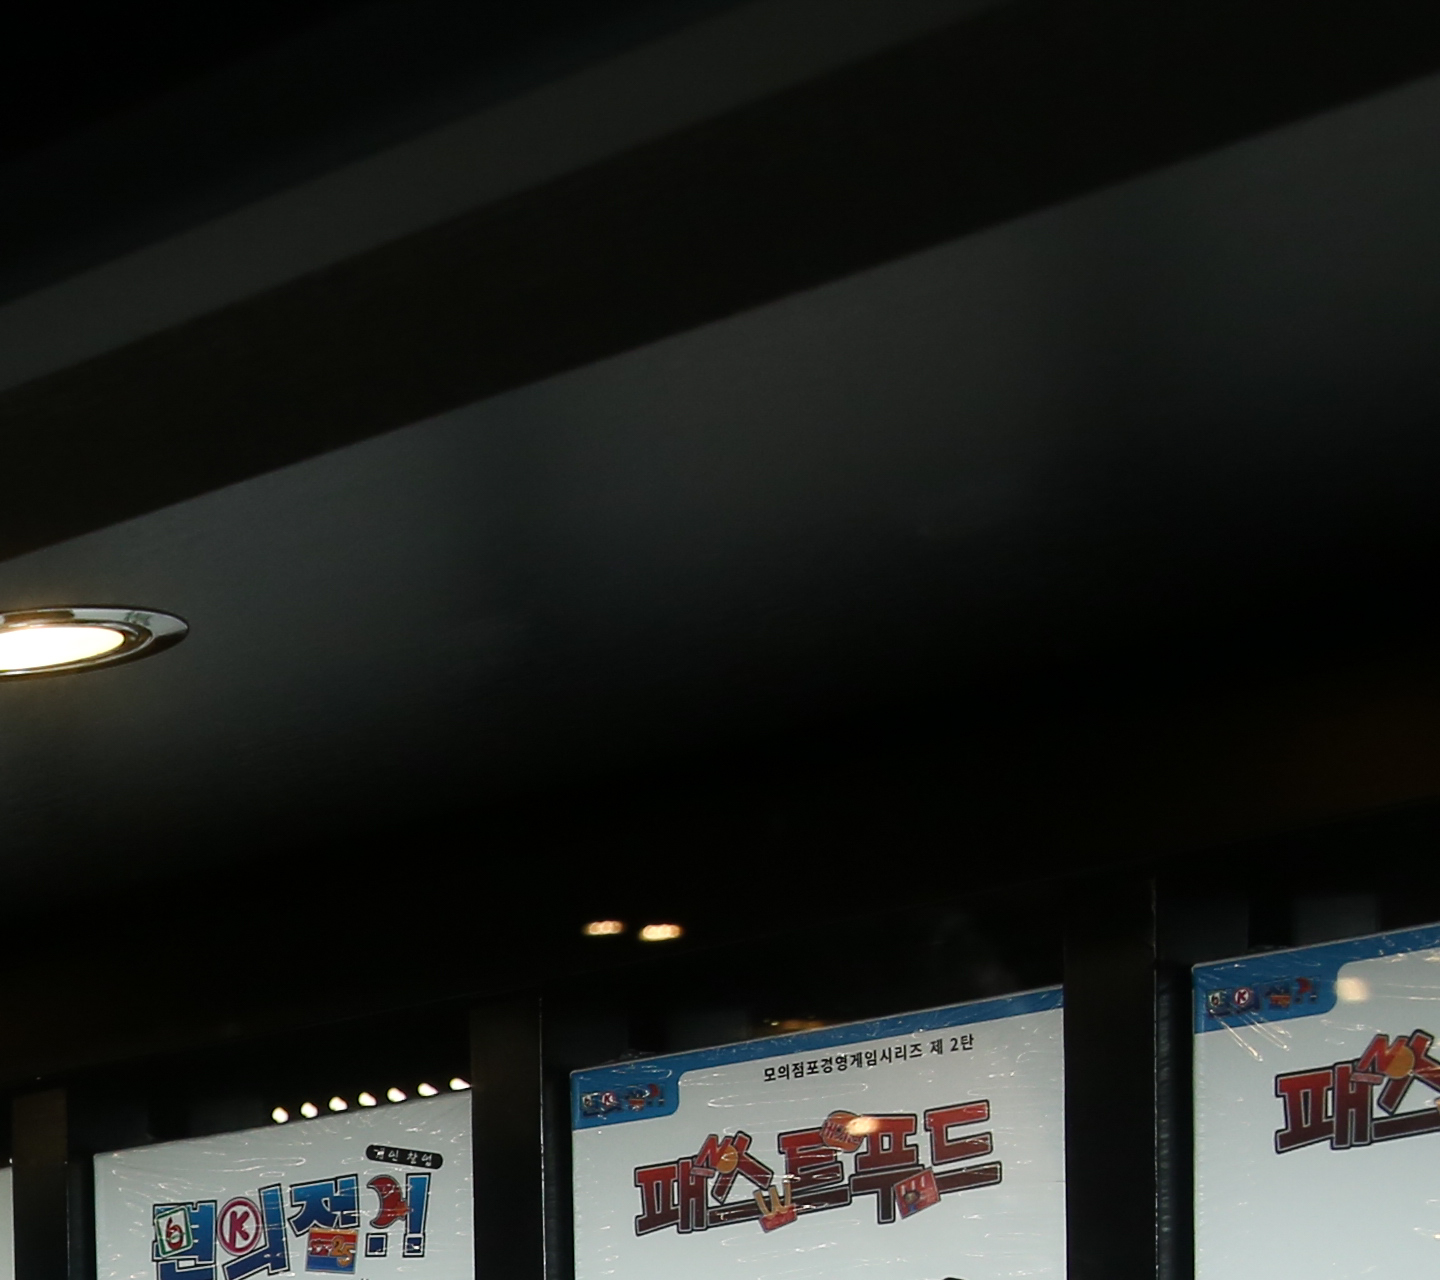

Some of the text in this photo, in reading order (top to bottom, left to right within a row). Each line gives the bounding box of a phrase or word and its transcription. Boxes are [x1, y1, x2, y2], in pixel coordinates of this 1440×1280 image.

[764, 1033, 975, 1082] 모의점포경영게임시리즈 제 2탄
[634, 1099, 1003, 1236] 패스트푸드
